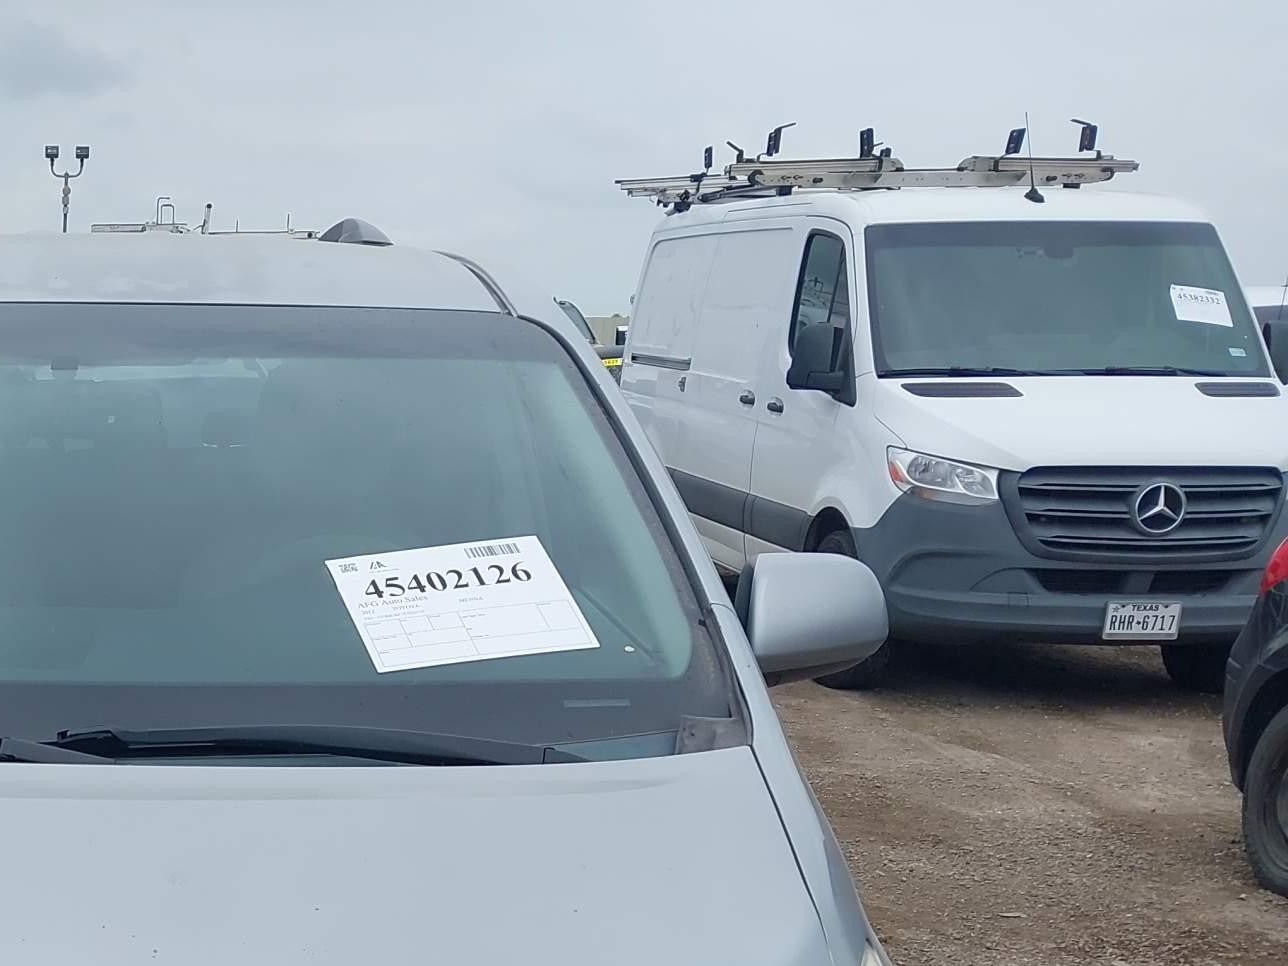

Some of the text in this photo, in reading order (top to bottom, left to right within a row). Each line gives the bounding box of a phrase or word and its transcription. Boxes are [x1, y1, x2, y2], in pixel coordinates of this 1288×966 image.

[365, 561, 532, 598] 45402126
[381, 599, 403, 607] Auto
[404, 595, 428, 603] Sales
